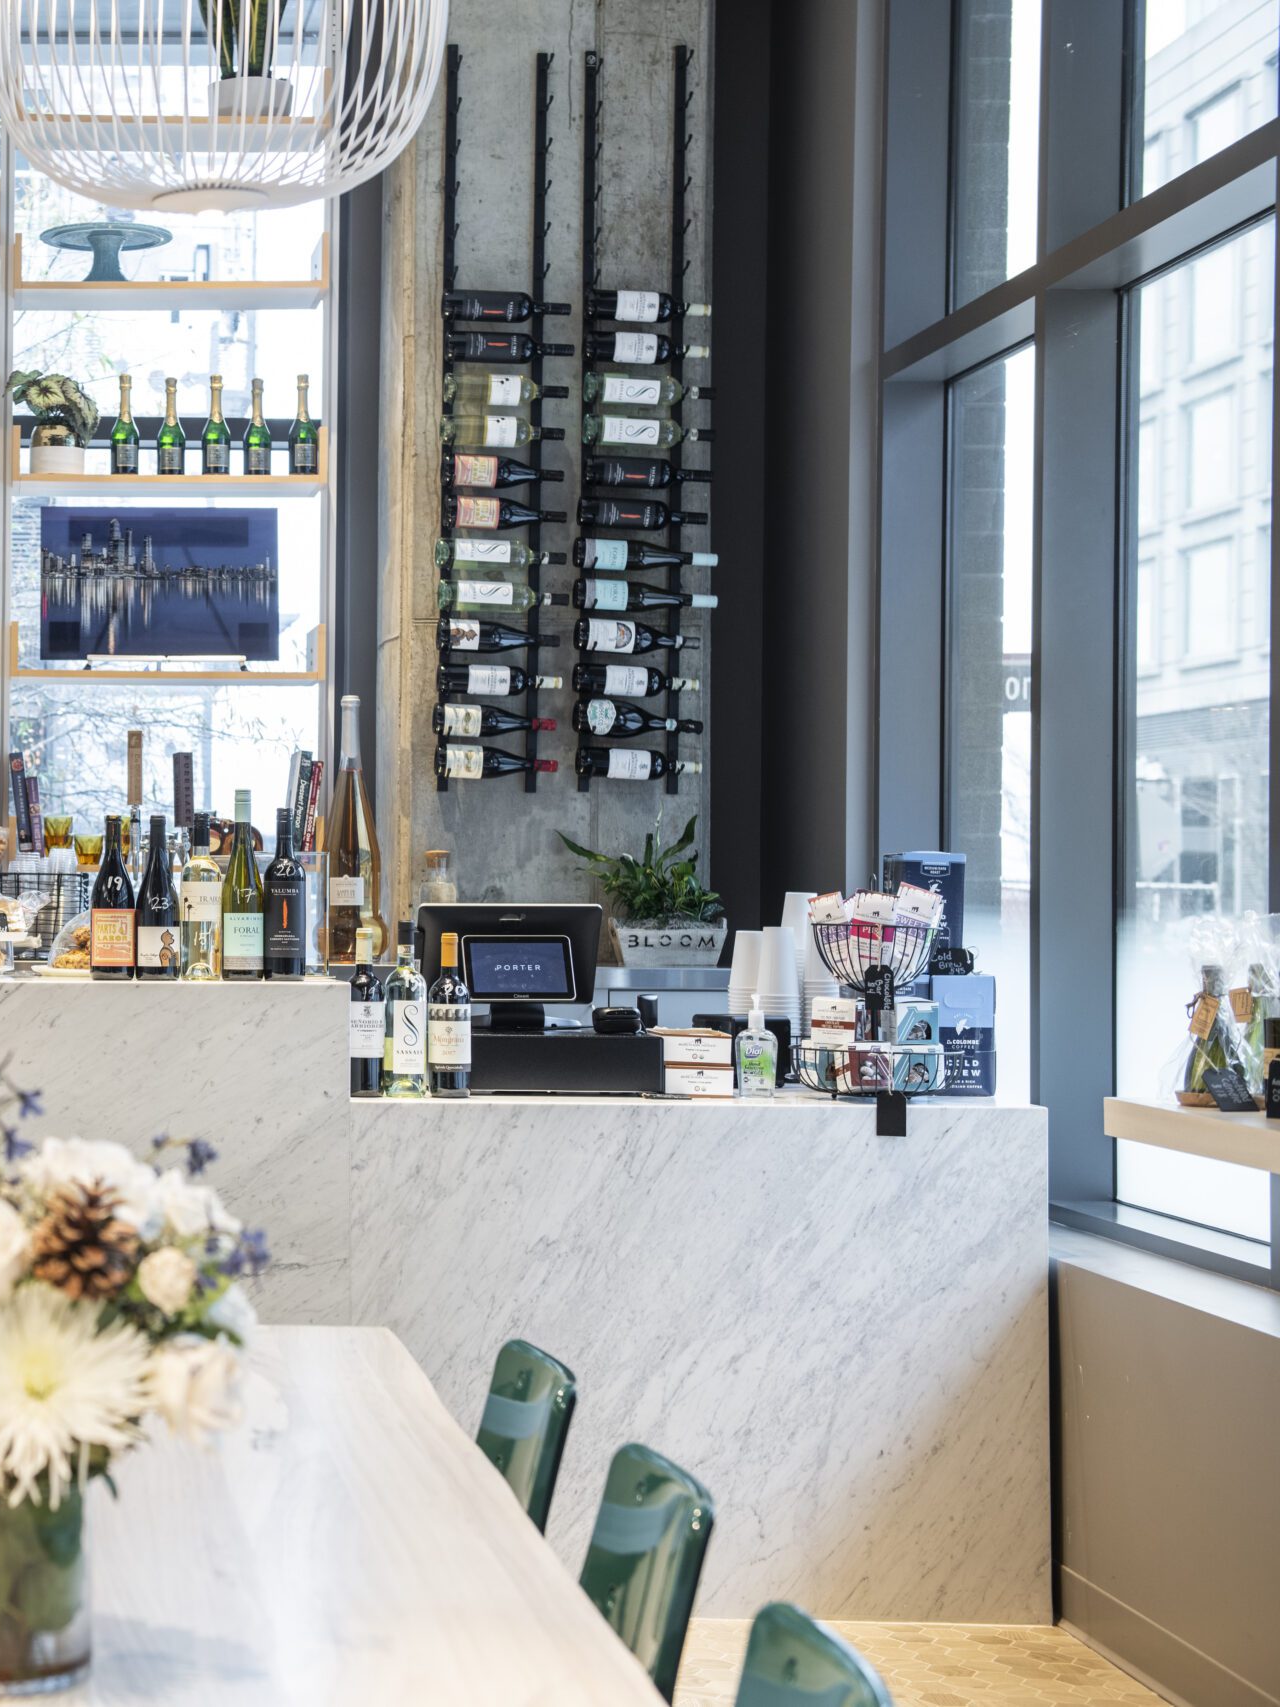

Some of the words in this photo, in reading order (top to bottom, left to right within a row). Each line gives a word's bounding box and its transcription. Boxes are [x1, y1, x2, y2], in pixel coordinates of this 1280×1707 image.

[298, 778, 308, 806] Dessert
[294, 804, 305, 829] Person
[106, 875, 124, 891] 19
[150, 896, 171, 911] 23
[233, 926, 260, 934] FORAL
[627, 934, 716, 949] BLOOM
[496, 963, 542, 972] PORTER
[938, 961, 963, 970] Brew
[744, 1046, 764, 1056] Dial
